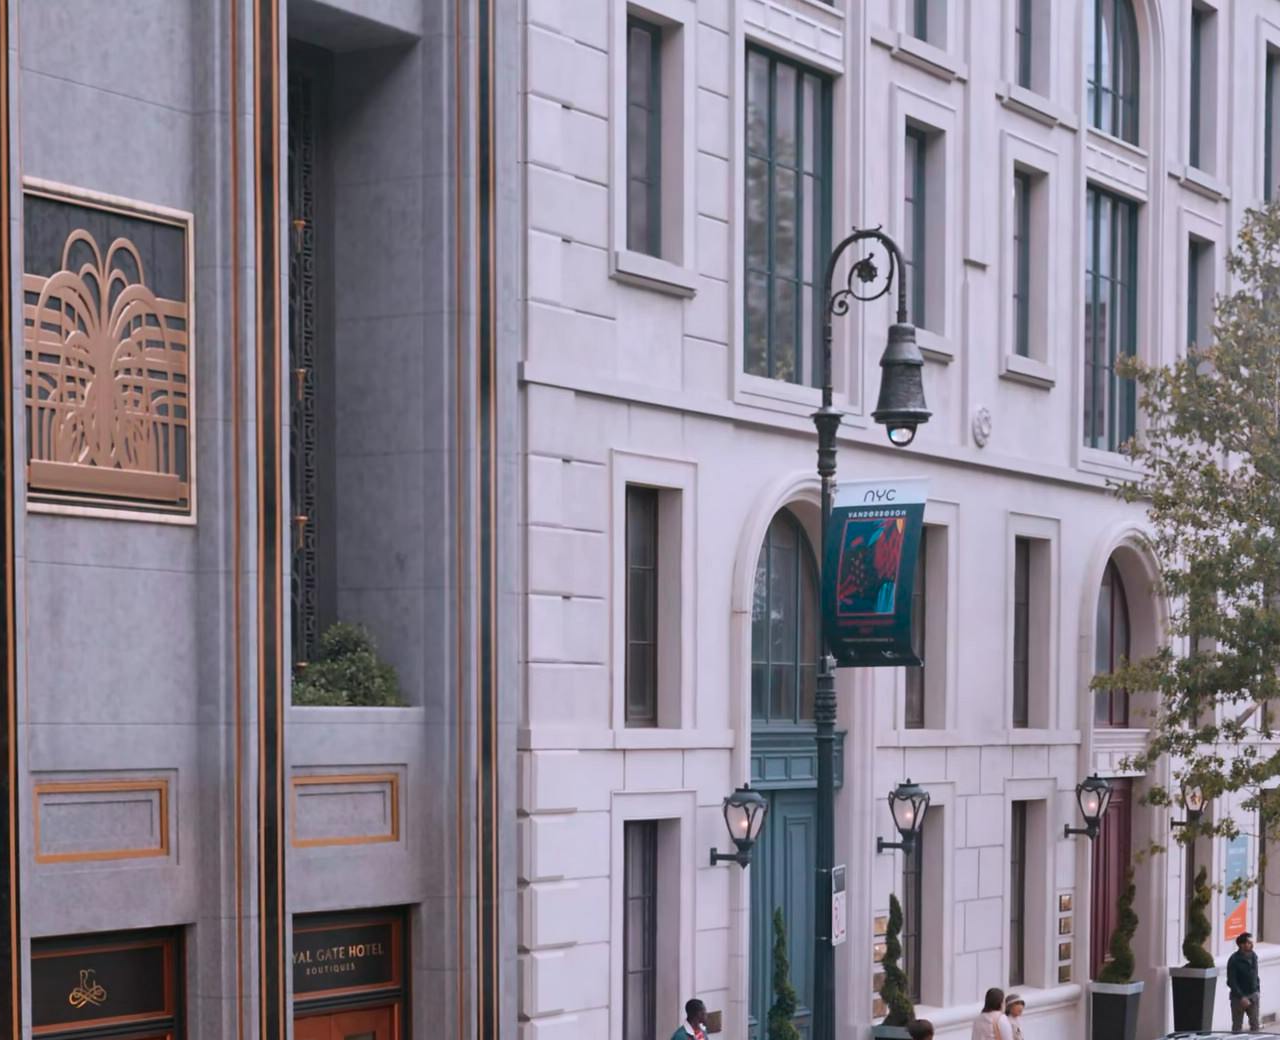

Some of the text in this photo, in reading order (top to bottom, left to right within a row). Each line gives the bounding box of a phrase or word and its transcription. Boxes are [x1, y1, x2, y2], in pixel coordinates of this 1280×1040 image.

[292, 943, 384, 965] YAL GATE HOTEL
[305, 962, 356, 976] BOUTIQUES
